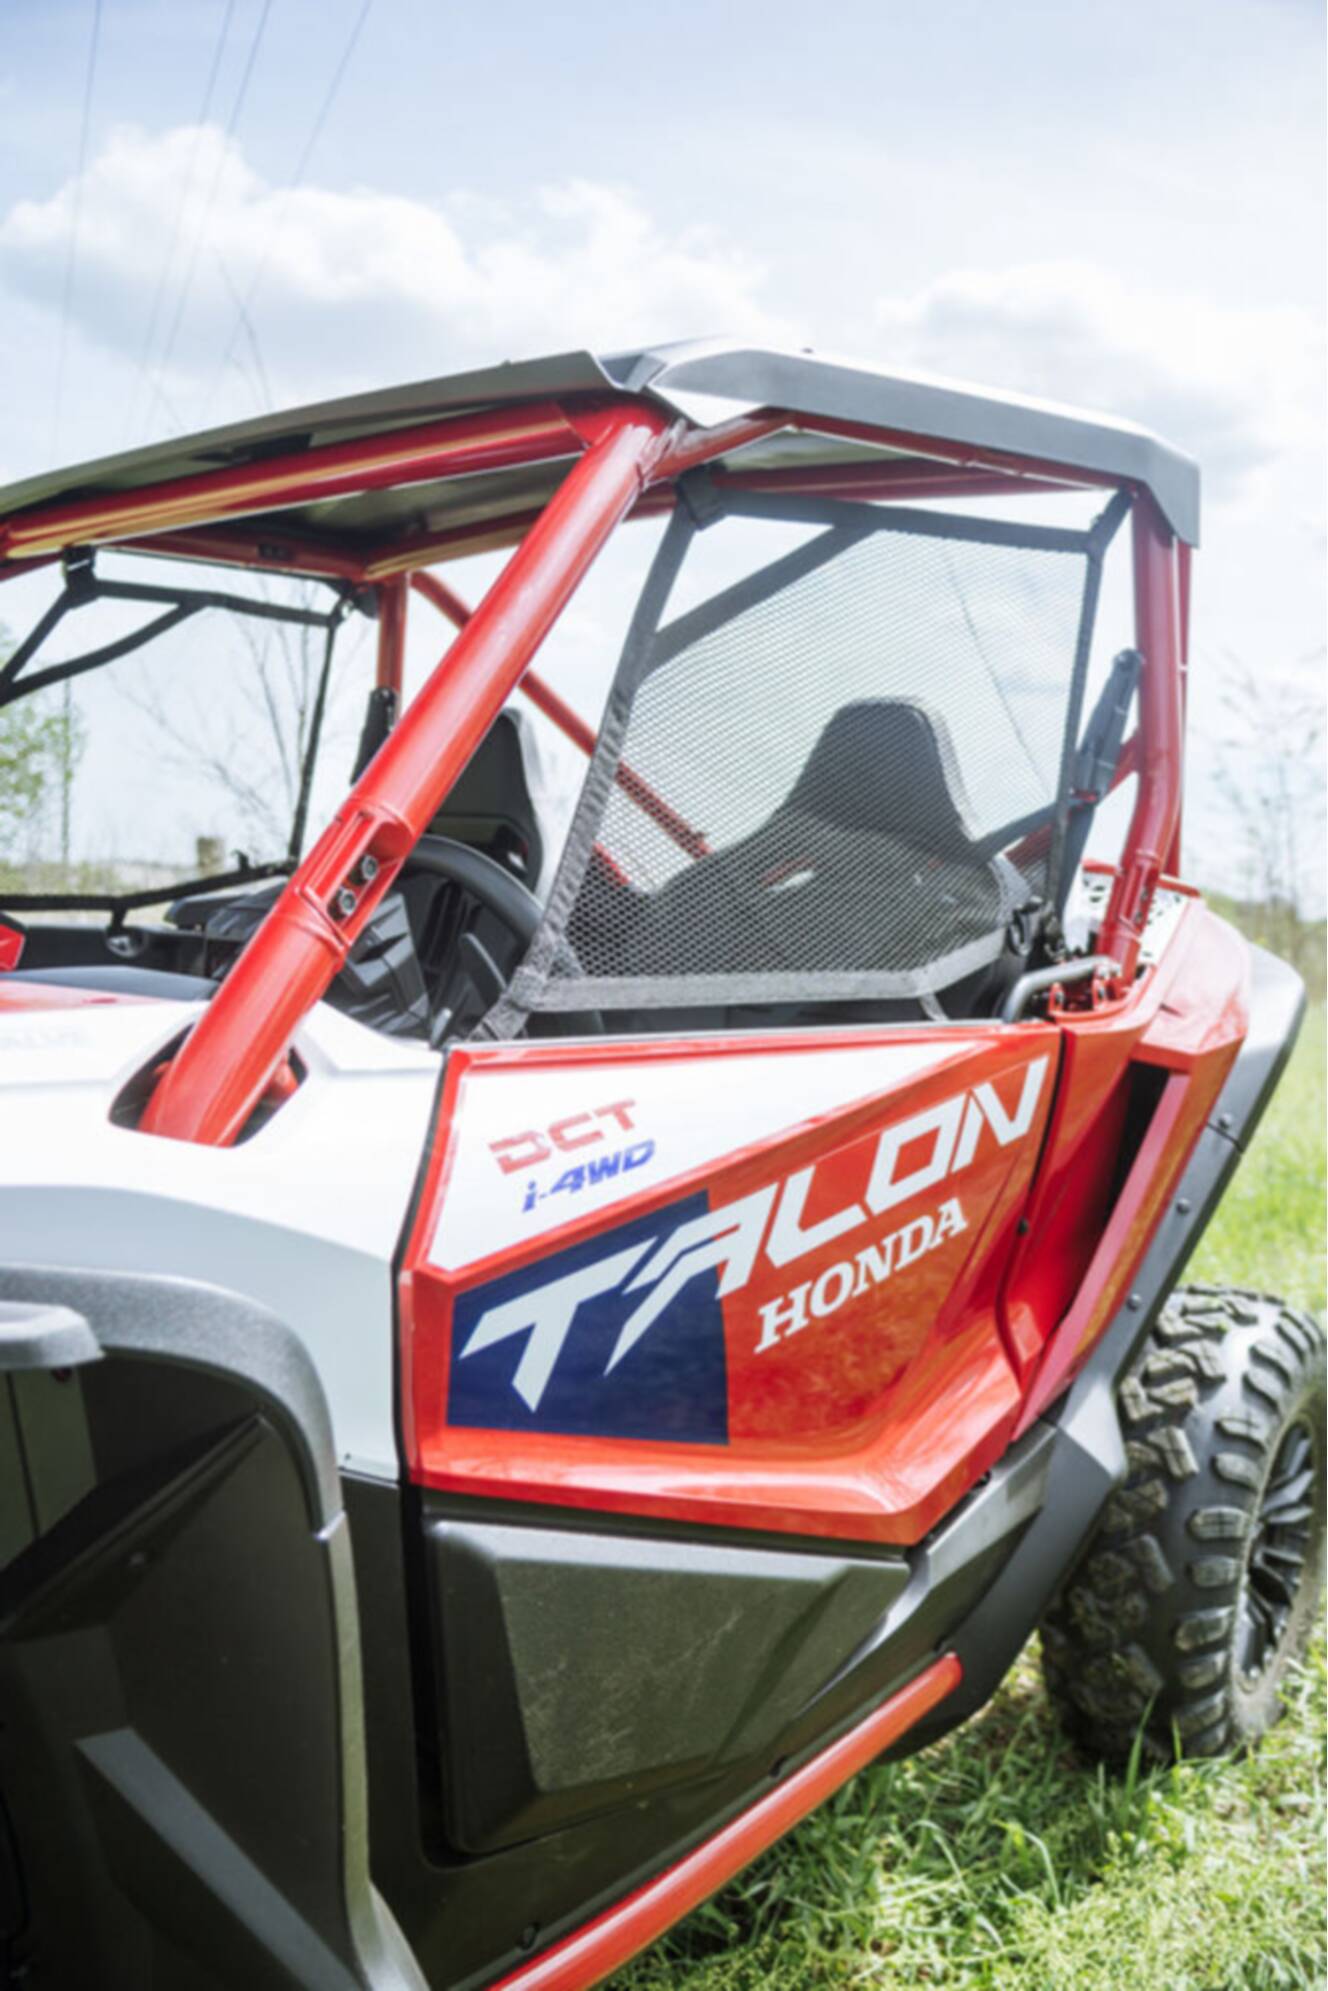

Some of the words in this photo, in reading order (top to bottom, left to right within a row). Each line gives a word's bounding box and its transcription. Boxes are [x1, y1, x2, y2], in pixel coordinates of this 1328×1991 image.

[488, 1098, 636, 1175] DCT
[522, 1139, 656, 1213] i-4WD
[459, 1056, 1050, 1413] TALON
[754, 1197, 967, 1354] HONDA
